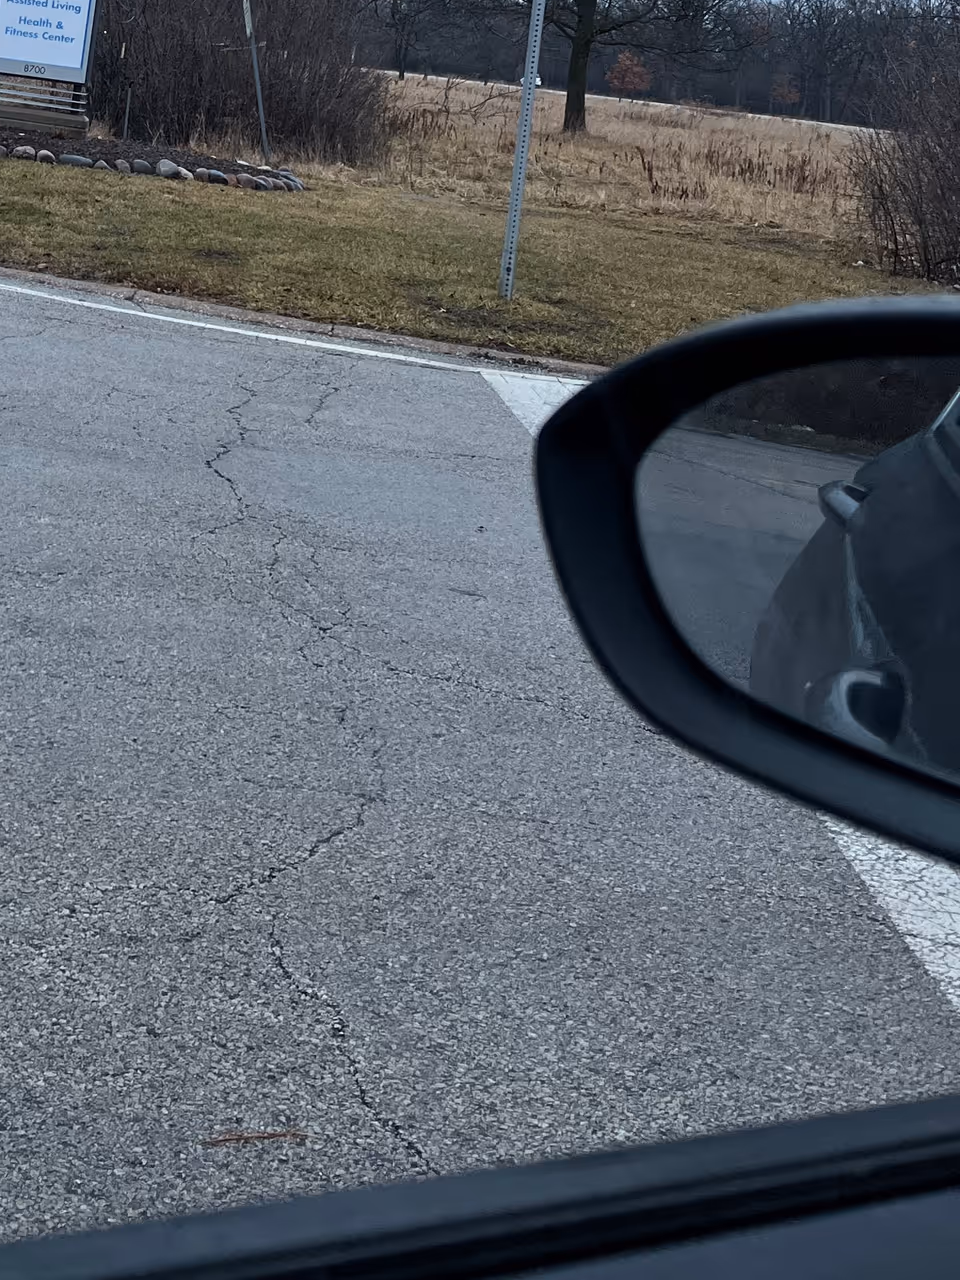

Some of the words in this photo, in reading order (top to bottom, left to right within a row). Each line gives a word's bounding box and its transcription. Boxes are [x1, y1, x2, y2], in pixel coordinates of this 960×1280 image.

[51, 0, 82, 15] Living
[18, 16, 52, 29] Health
[56, 21, 64, 30] &
[4, 26, 39, 39] Fitness
[42, 32, 75, 43] Center
[23, 64, 46, 74] 8700
